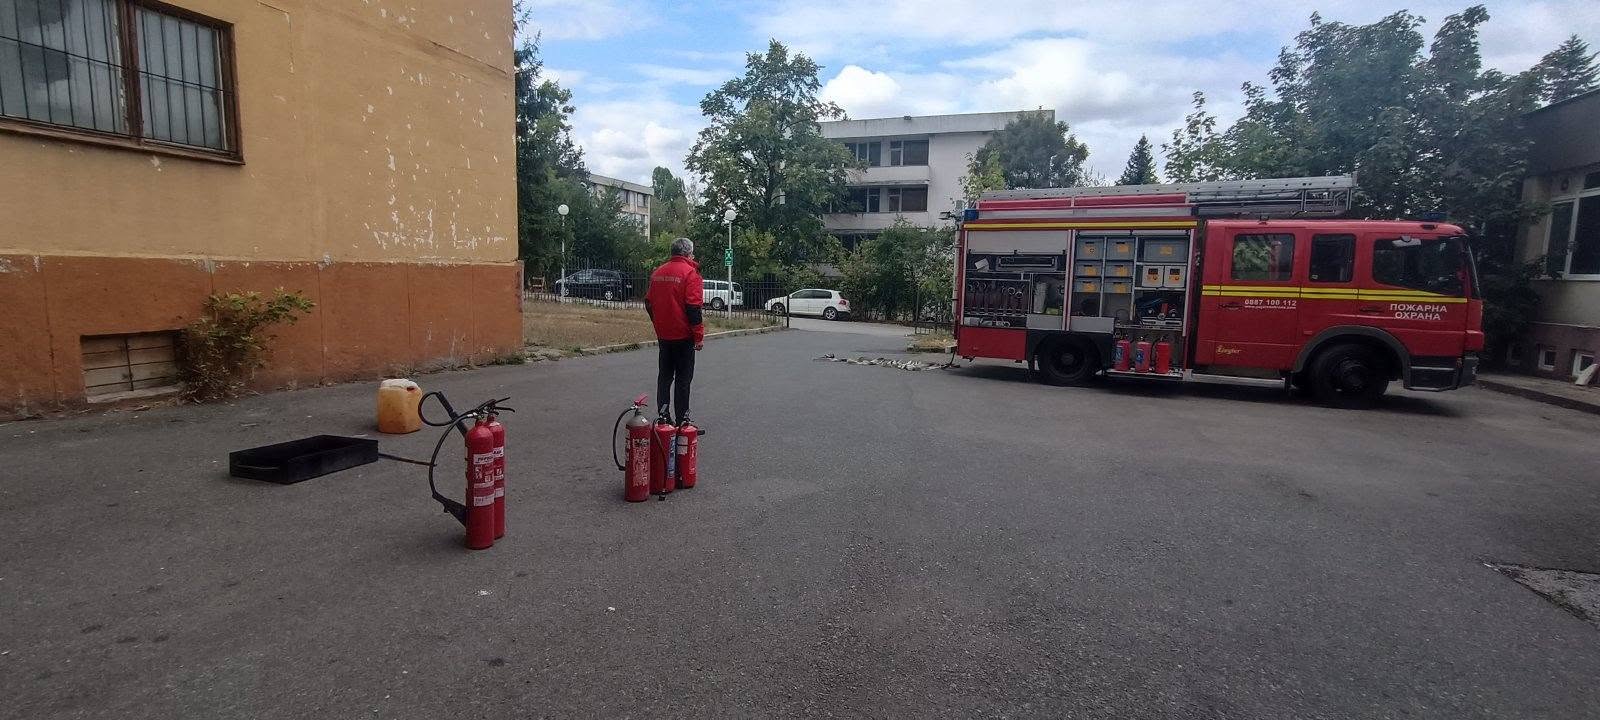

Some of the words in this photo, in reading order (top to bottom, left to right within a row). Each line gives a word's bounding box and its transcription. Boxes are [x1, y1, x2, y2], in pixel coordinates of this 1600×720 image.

[1283, 299, 1297, 307] 112
[1390, 303, 1448, 313] ПОЖАРНА
[1394, 311, 1441, 321] ОХРАНА
